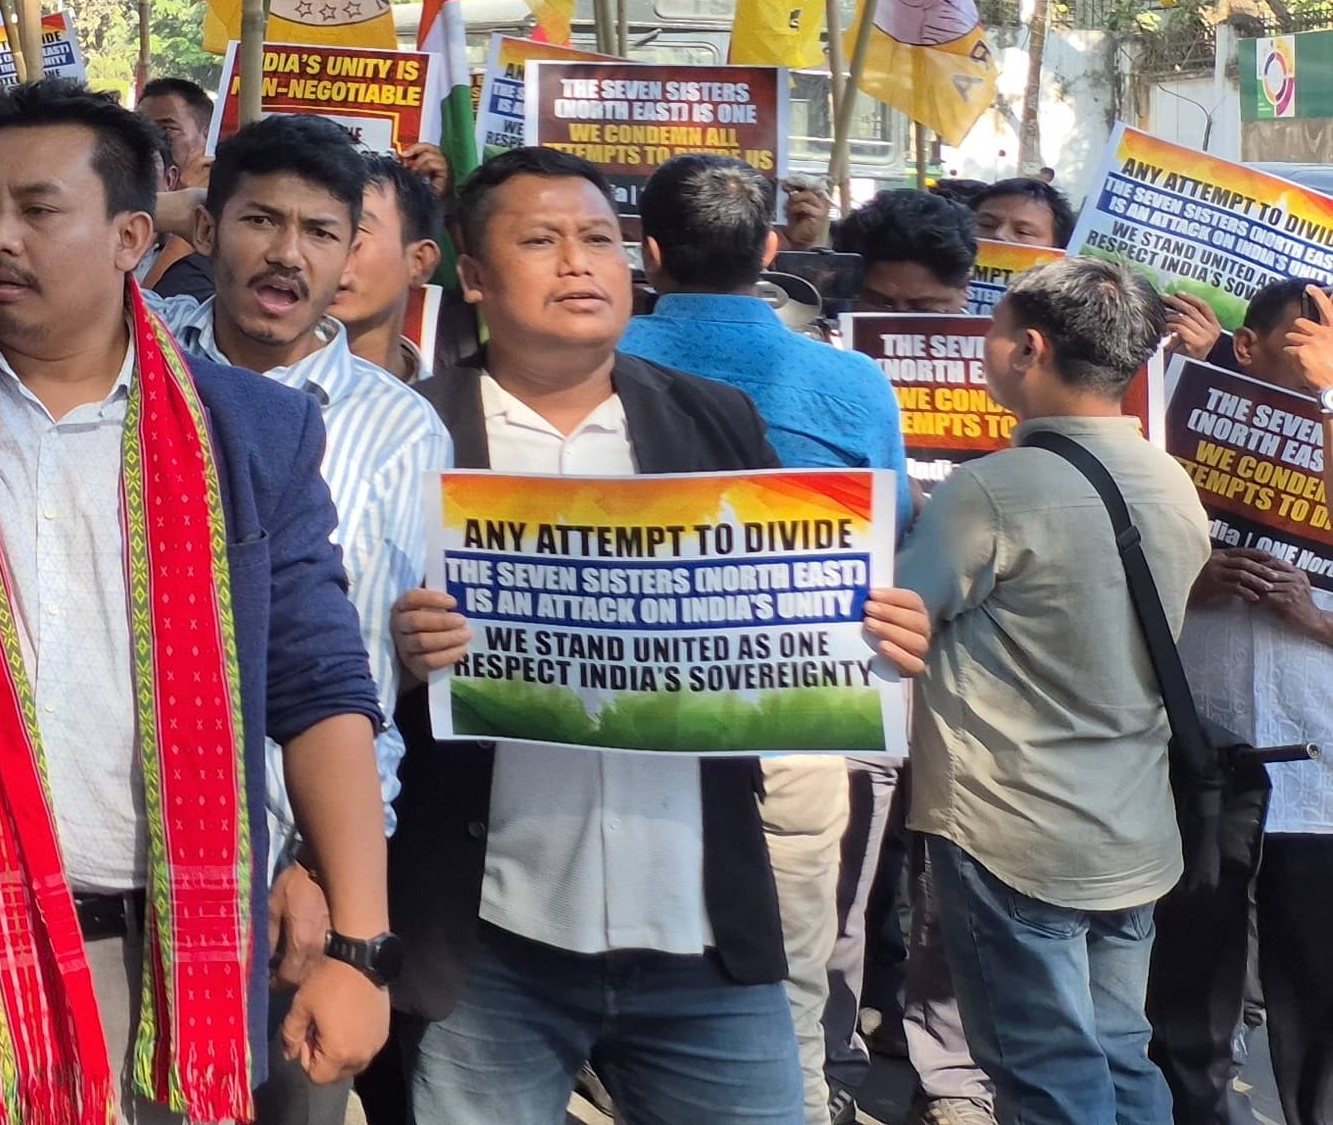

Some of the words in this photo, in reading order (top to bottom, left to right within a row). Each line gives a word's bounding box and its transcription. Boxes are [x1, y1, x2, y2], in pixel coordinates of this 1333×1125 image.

[326, 56, 391, 79] UNITY
[397, 60, 419, 81] IS
[232, 77, 421, 107] NN-NEGOTIABLE
[562, 79, 599, 99] THE
[601, 79, 661, 100] SEVEN
[666, 82, 750, 103] SISTERS
[636, 102, 688, 121] EAST)
[693, 103, 713, 123] IS
[717, 105, 757, 124] ONE
[568, 123, 603, 142] WE
[604, 125, 704, 145] CONDEMN
[706, 129, 738, 147] ALL
[746, 149, 773, 170] US
[1122, 158, 1162, 185] ANY
[1164, 173, 1254, 214] ATTEMPT
[1259, 201, 1282, 226] TO
[1087, 230, 1161, 264] RESPECT
[1161, 255, 1222, 288] INDIA'S
[1112, 221, 1138, 241] WE
[1141, 232, 1197, 260] STAND
[1201, 252, 1254, 281] UNITED
[880, 334, 925, 357] THE
[898, 387, 932, 410] WE
[1206, 387, 1252, 421] THE
[1188, 409, 1281, 457] (NORTH
[1196, 440, 1236, 470] WE
[1278, 494, 1308, 522] TO
[463, 518, 526, 551] ANY
[536, 524, 686, 559] ATTEMPT
[697, 522, 733, 555] TO
[743, 518, 853, 553] DIVIDE
[445, 558, 493, 587] THE
[496, 561, 577, 592] SEVEN
[581, 565, 690, 596] SISTERS
[696, 561, 788, 593] (NORTH
[793, 559, 866, 589] EAST)
[466, 589, 489, 615] IS
[496, 592, 532, 616] AN
[536, 594, 634, 623] ATTACK
[640, 597, 676, 623] ON
[682, 593, 774, 622] INDIA'S
[778, 589, 855, 618] UNITY
[485, 625, 529, 654] WE
[535, 631, 625, 661] STAND
[634, 633, 730, 664] UNITED
[736, 633, 774, 662] AS
[781, 630, 830, 658] ONE
[453, 653, 571, 686] RESPECT
[579, 659, 681, 693] INDIA'S
[688, 655, 874, 691] SOVEREIGNTY
